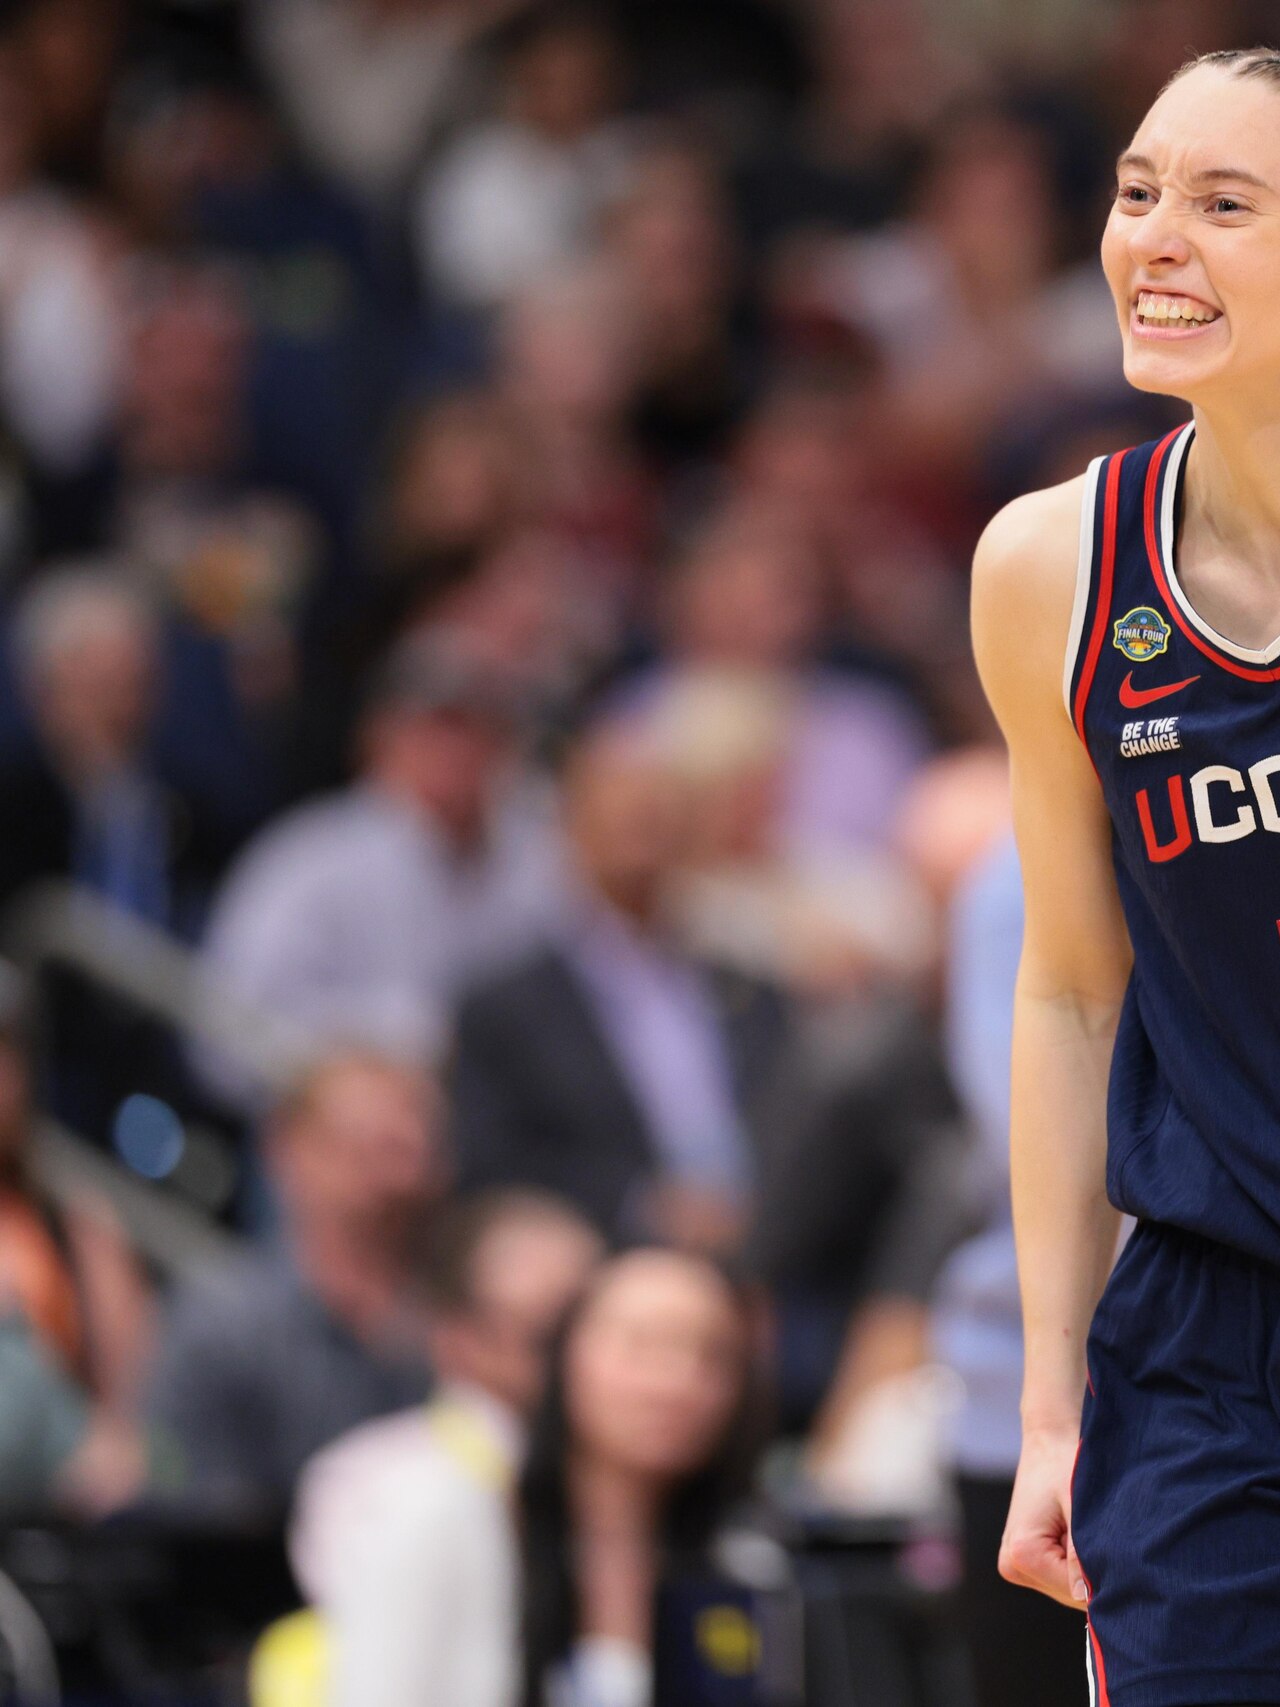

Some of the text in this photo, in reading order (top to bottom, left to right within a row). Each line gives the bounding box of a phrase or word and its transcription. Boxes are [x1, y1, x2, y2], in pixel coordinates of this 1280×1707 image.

[1118, 628, 1141, 640] FINAL
[1142, 629, 1164, 644] FOUR
[1122, 716, 1179, 741] BE THE
[1120, 732, 1181, 758] CHANGE
